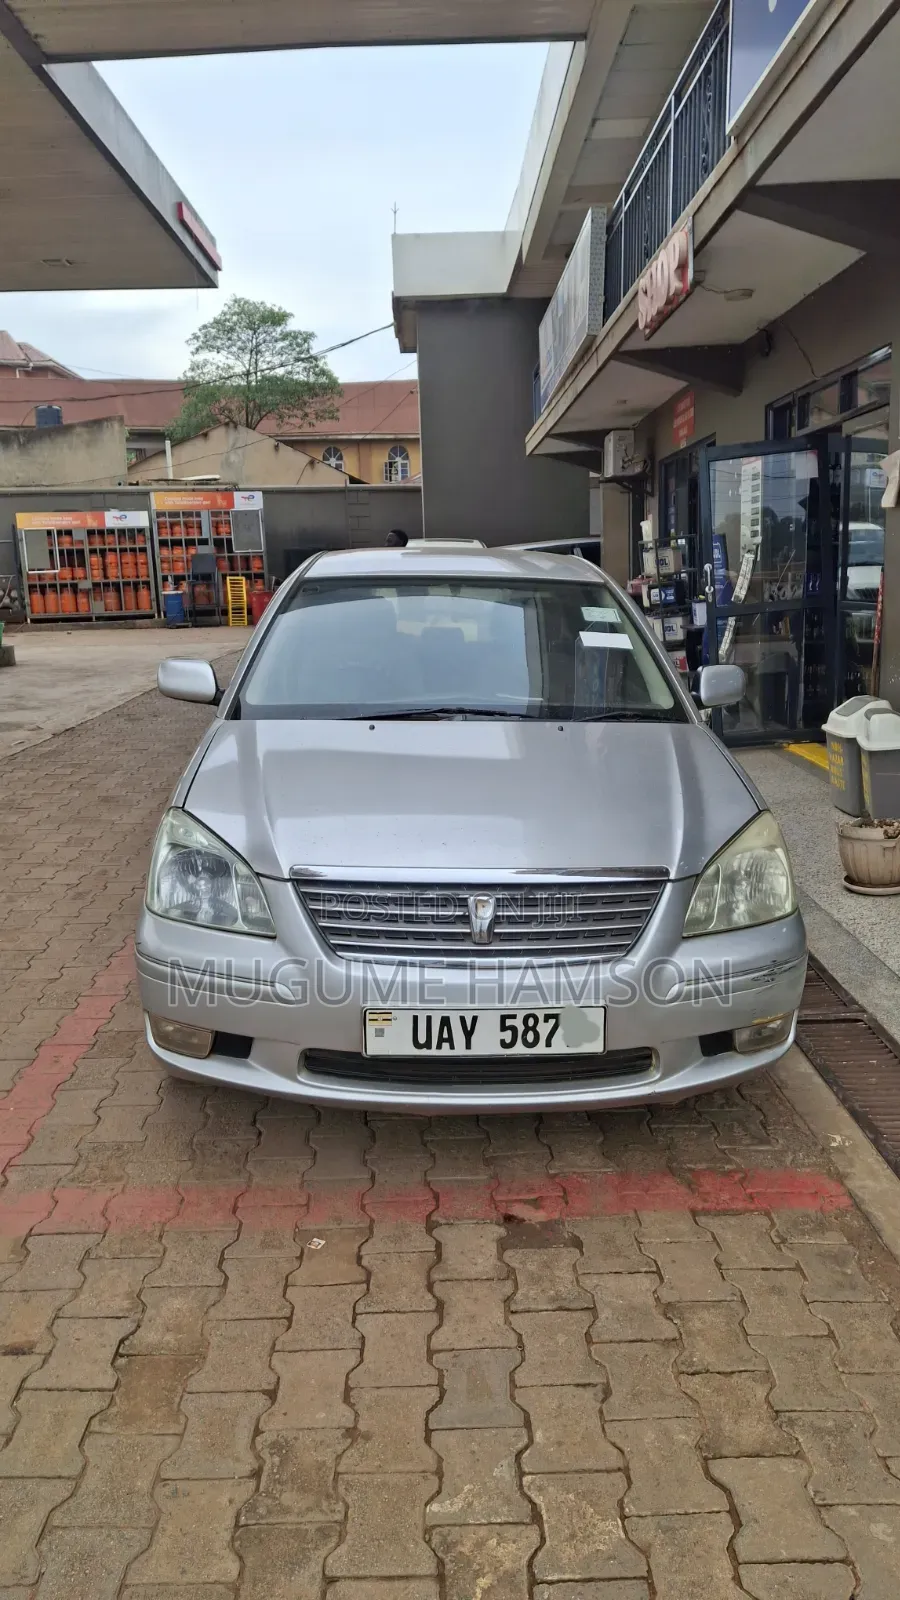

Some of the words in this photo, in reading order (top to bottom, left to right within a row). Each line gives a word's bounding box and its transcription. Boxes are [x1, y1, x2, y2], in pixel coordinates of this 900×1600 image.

[638, 231, 687, 330] SHOP
[412, 1014, 479, 1050] UAY
[499, 1013, 572, 1049] 587
